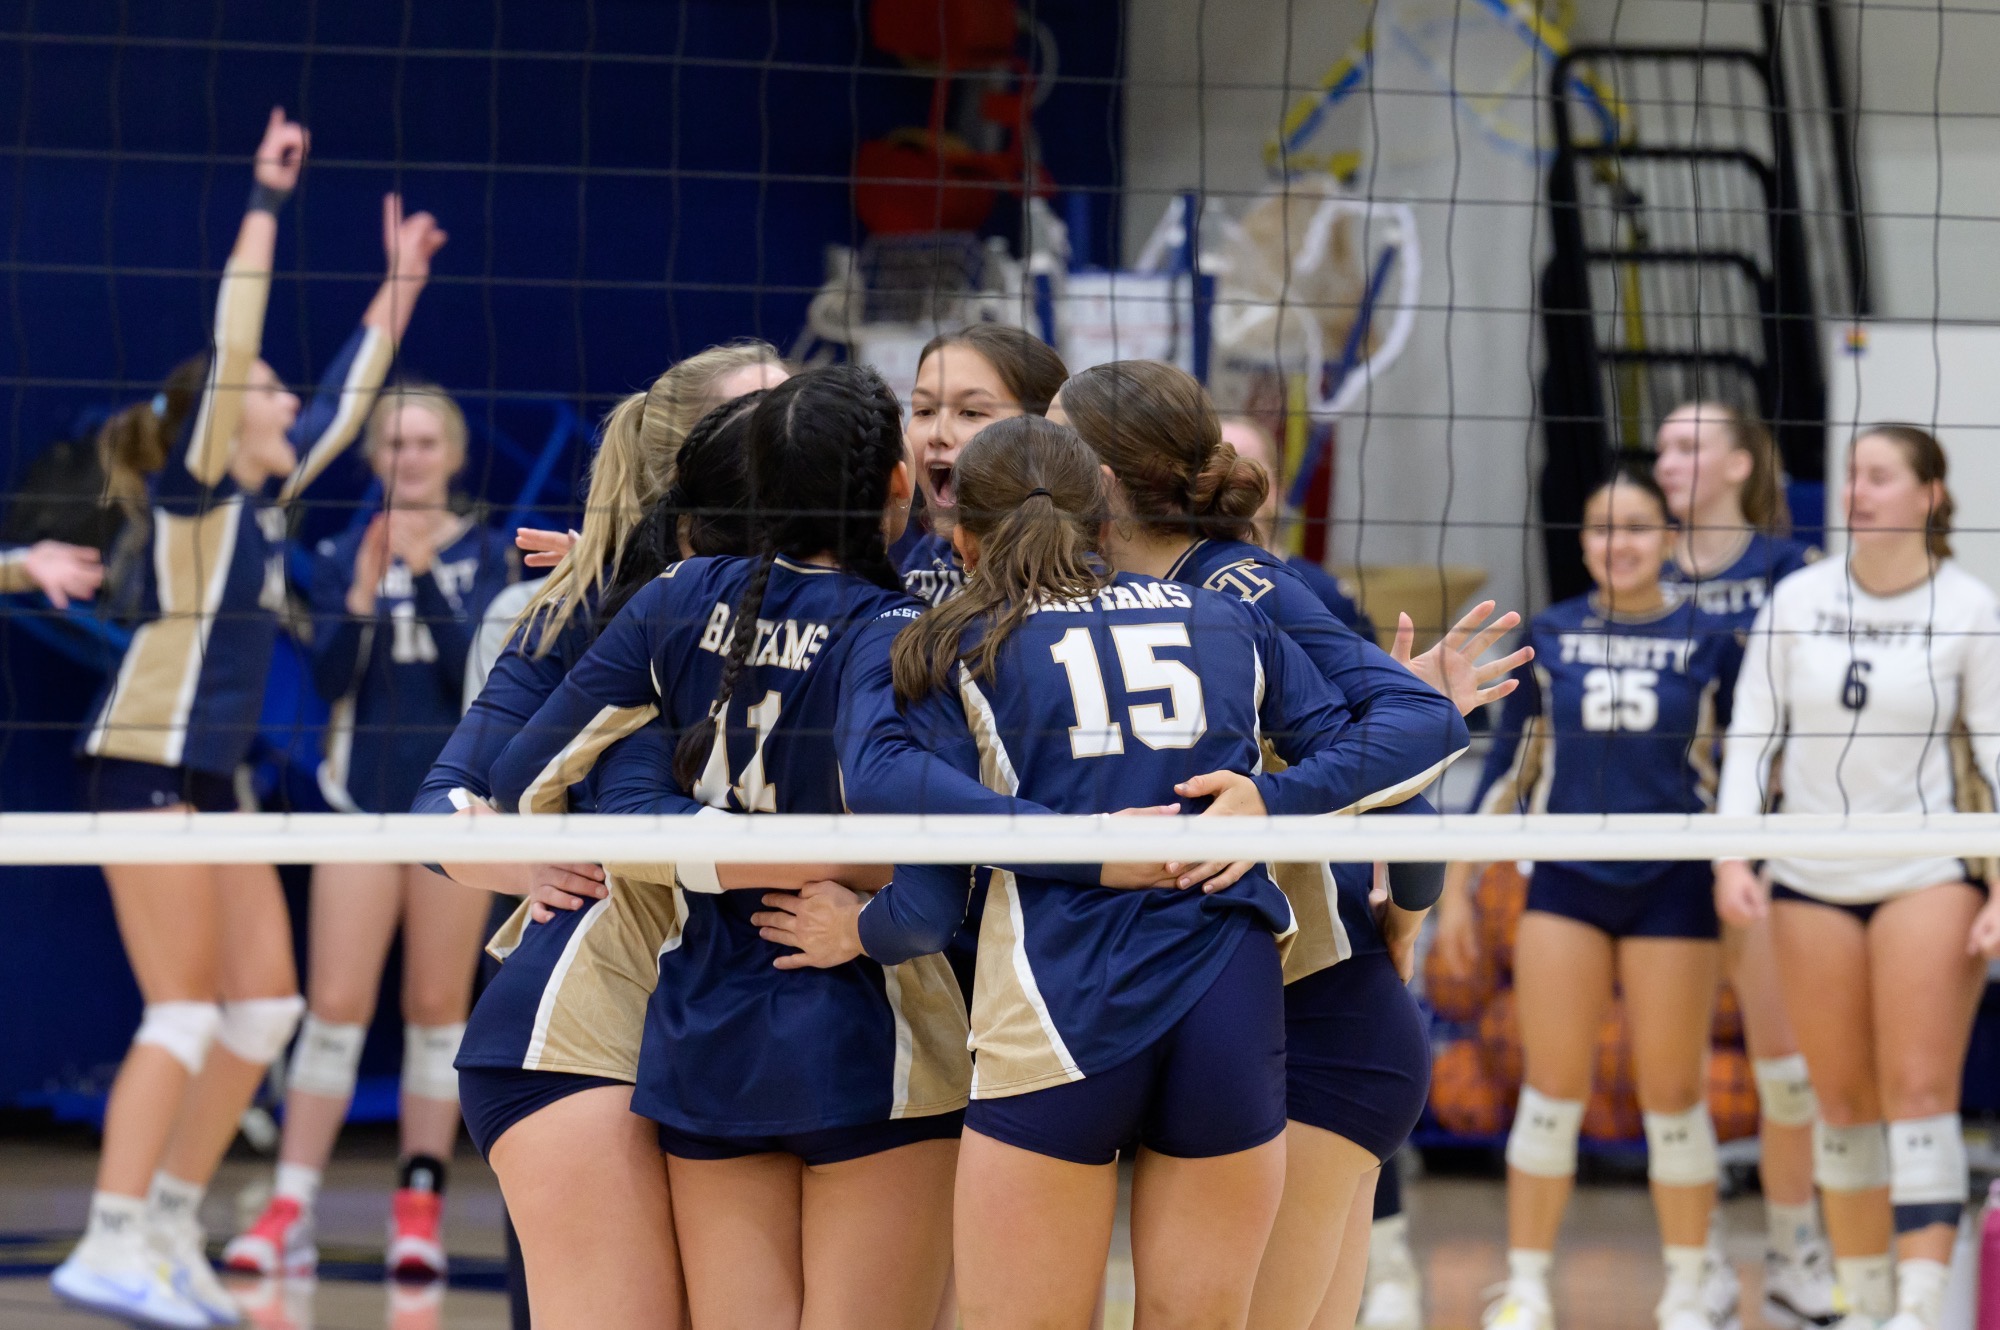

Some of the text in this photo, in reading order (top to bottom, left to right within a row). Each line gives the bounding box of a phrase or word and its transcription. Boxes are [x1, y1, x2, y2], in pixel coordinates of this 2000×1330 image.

[1050, 622, 1207, 759] 15
[1581, 667, 1660, 731] 25
[1842, 660, 1873, 710] 6
[693, 690, 782, 814] 11
